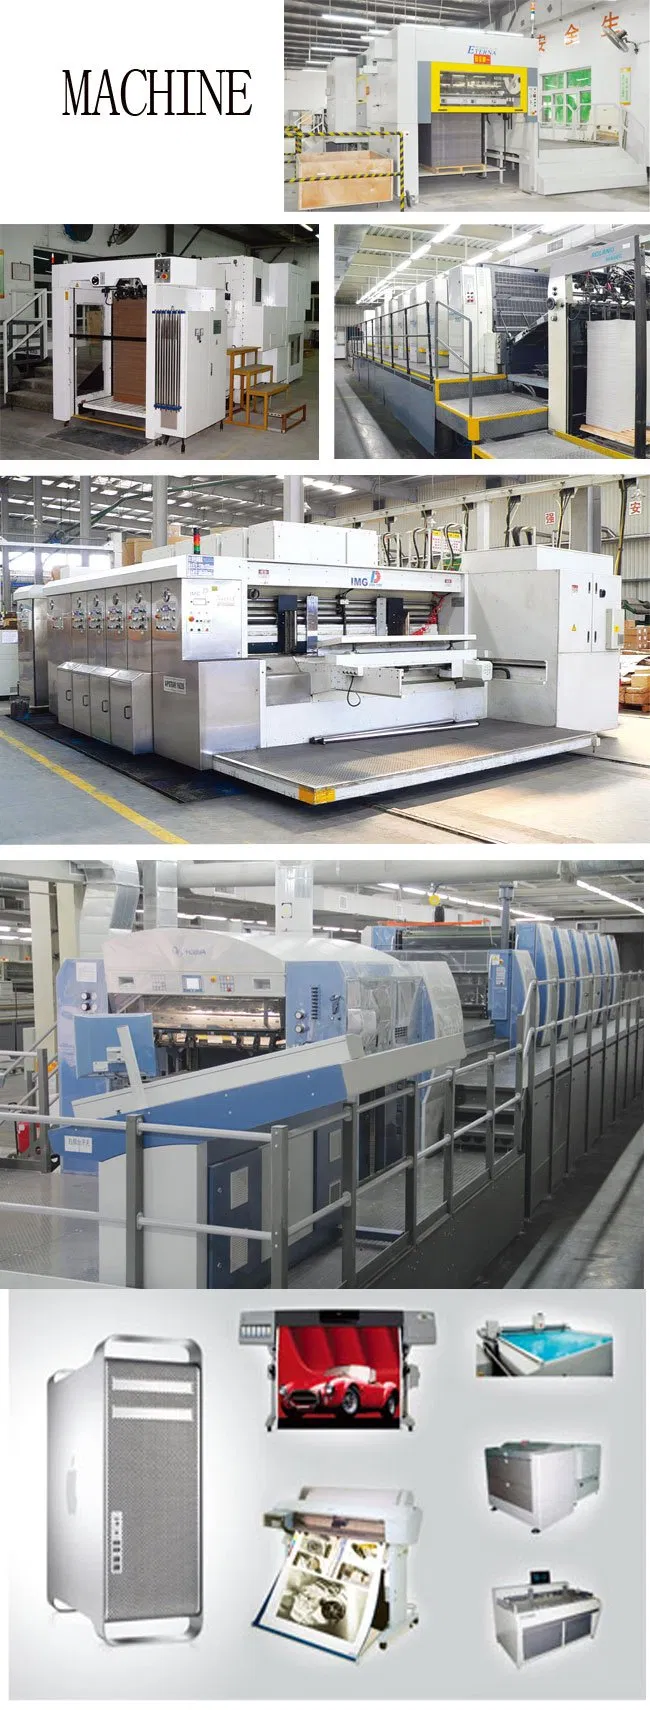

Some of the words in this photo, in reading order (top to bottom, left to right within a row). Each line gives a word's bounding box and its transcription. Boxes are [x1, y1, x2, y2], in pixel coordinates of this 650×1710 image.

[467, 45, 497, 55] ETERNA
[630, 501, 641, 514] 安
[545, 512, 555, 523] 强
[351, 577, 368, 587] IMG
